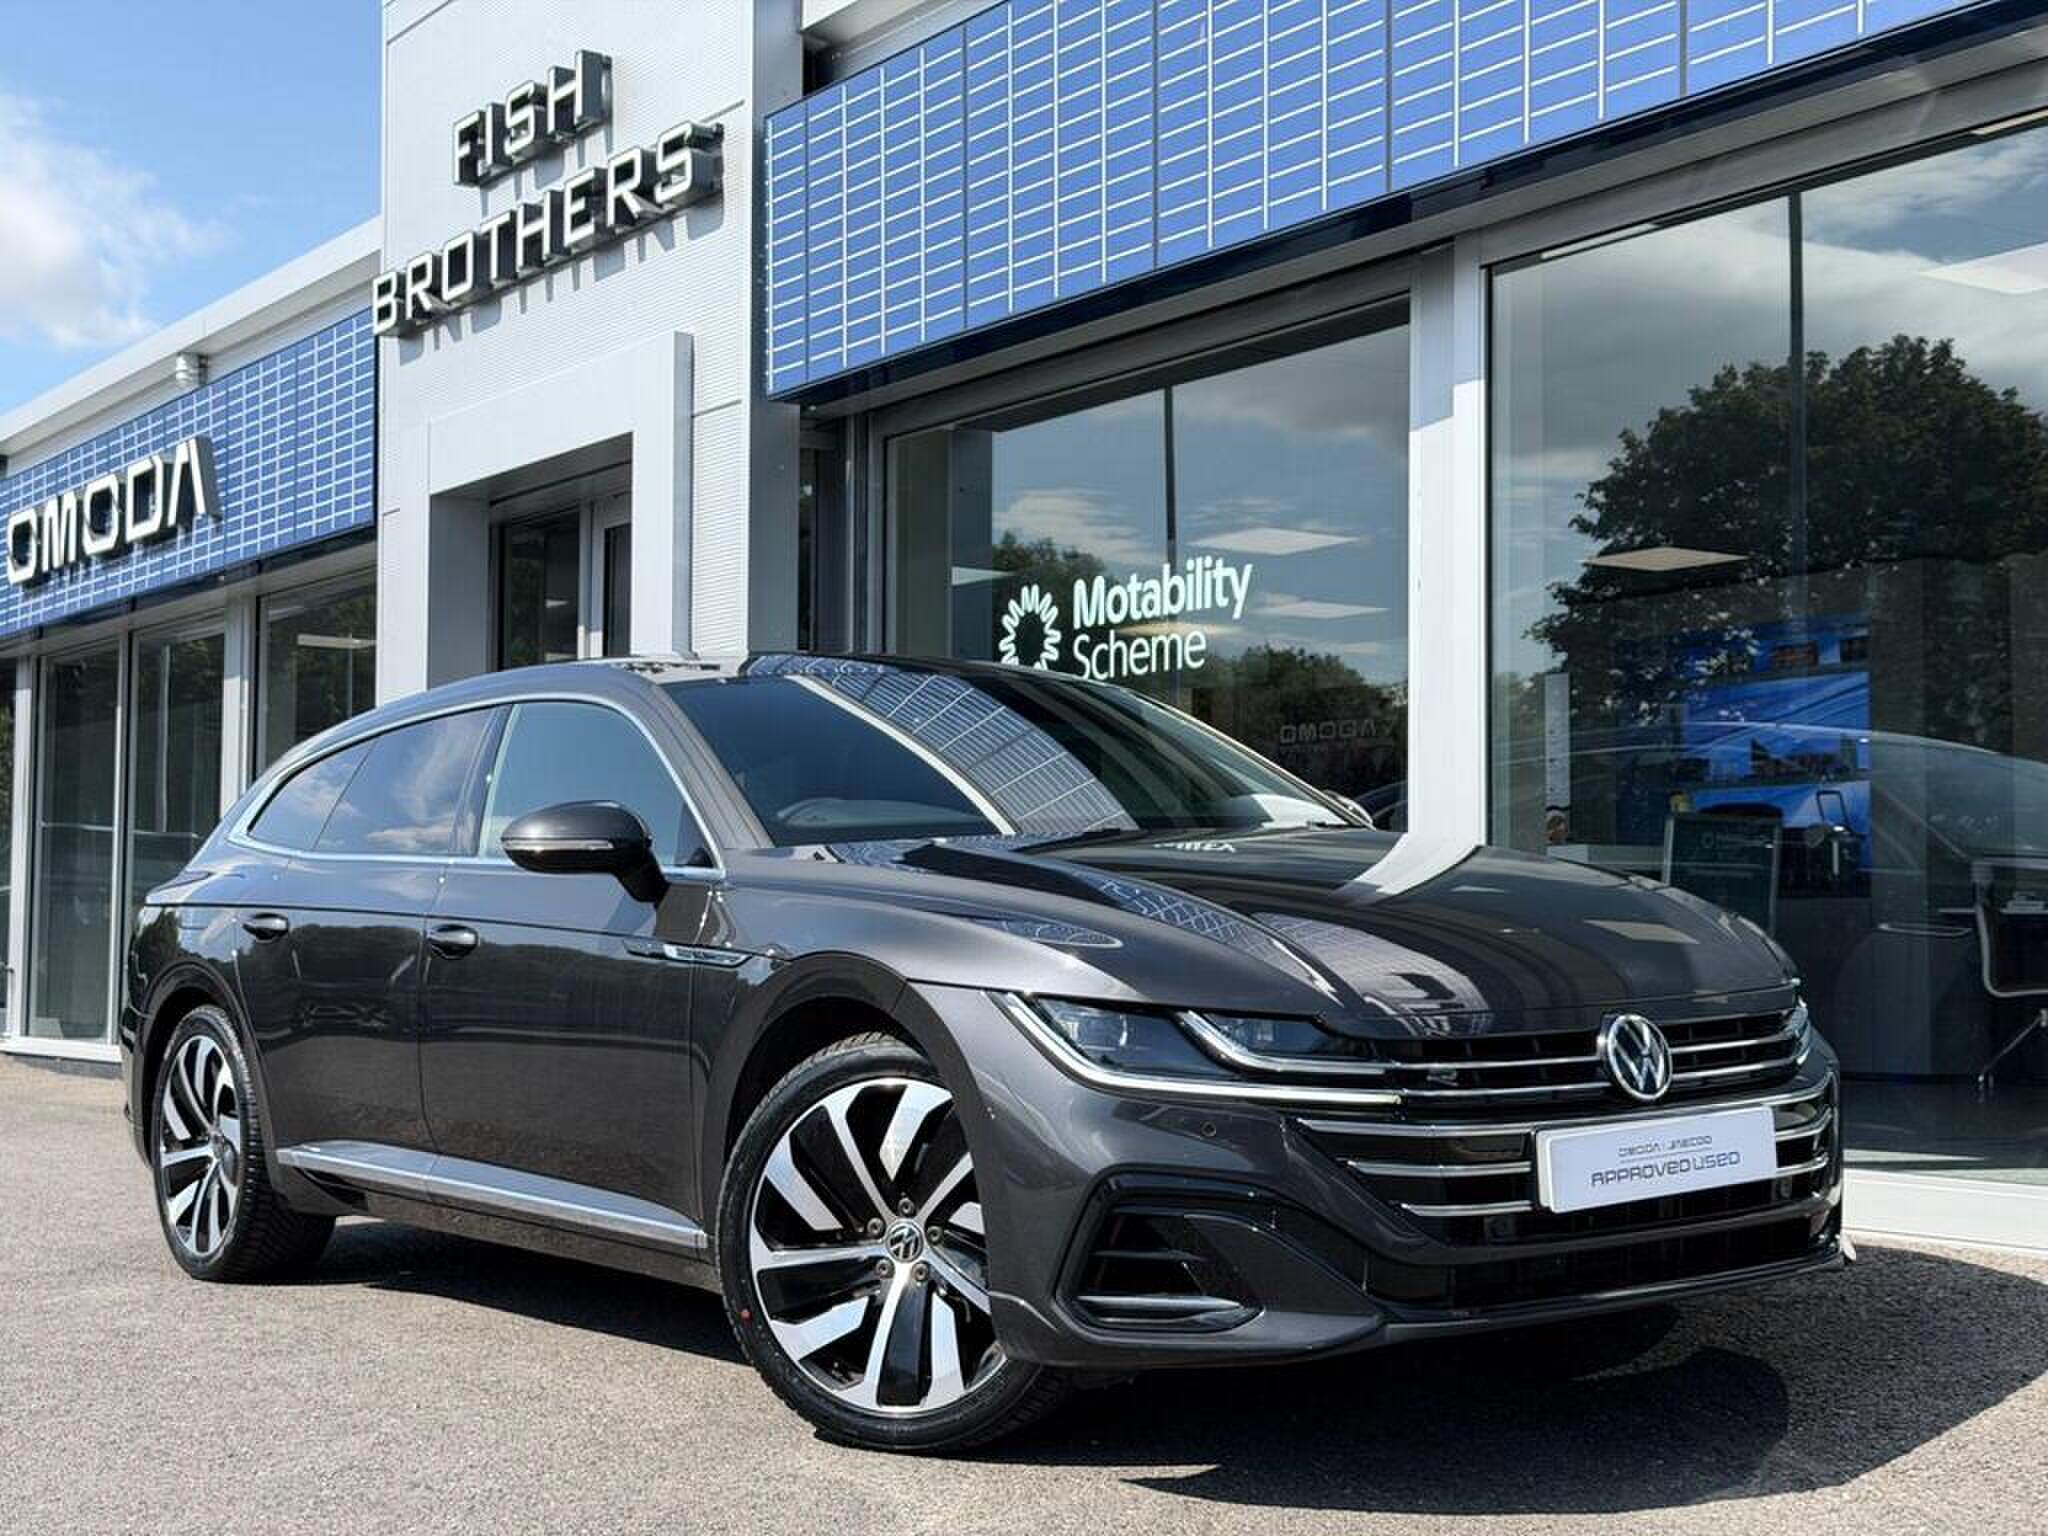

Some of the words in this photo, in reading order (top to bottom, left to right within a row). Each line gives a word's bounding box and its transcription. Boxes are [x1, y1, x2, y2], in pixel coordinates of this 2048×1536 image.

[453, 49, 603, 187] FISH
[372, 121, 708, 336] BROTHERS
[7, 437, 210, 587] OMODA
[1073, 556, 1253, 630] Motability
[1073, 629, 1207, 681] Scheme
[1591, 1157, 1691, 1187] APPROVED
[1693, 1151, 1741, 1170] USED
